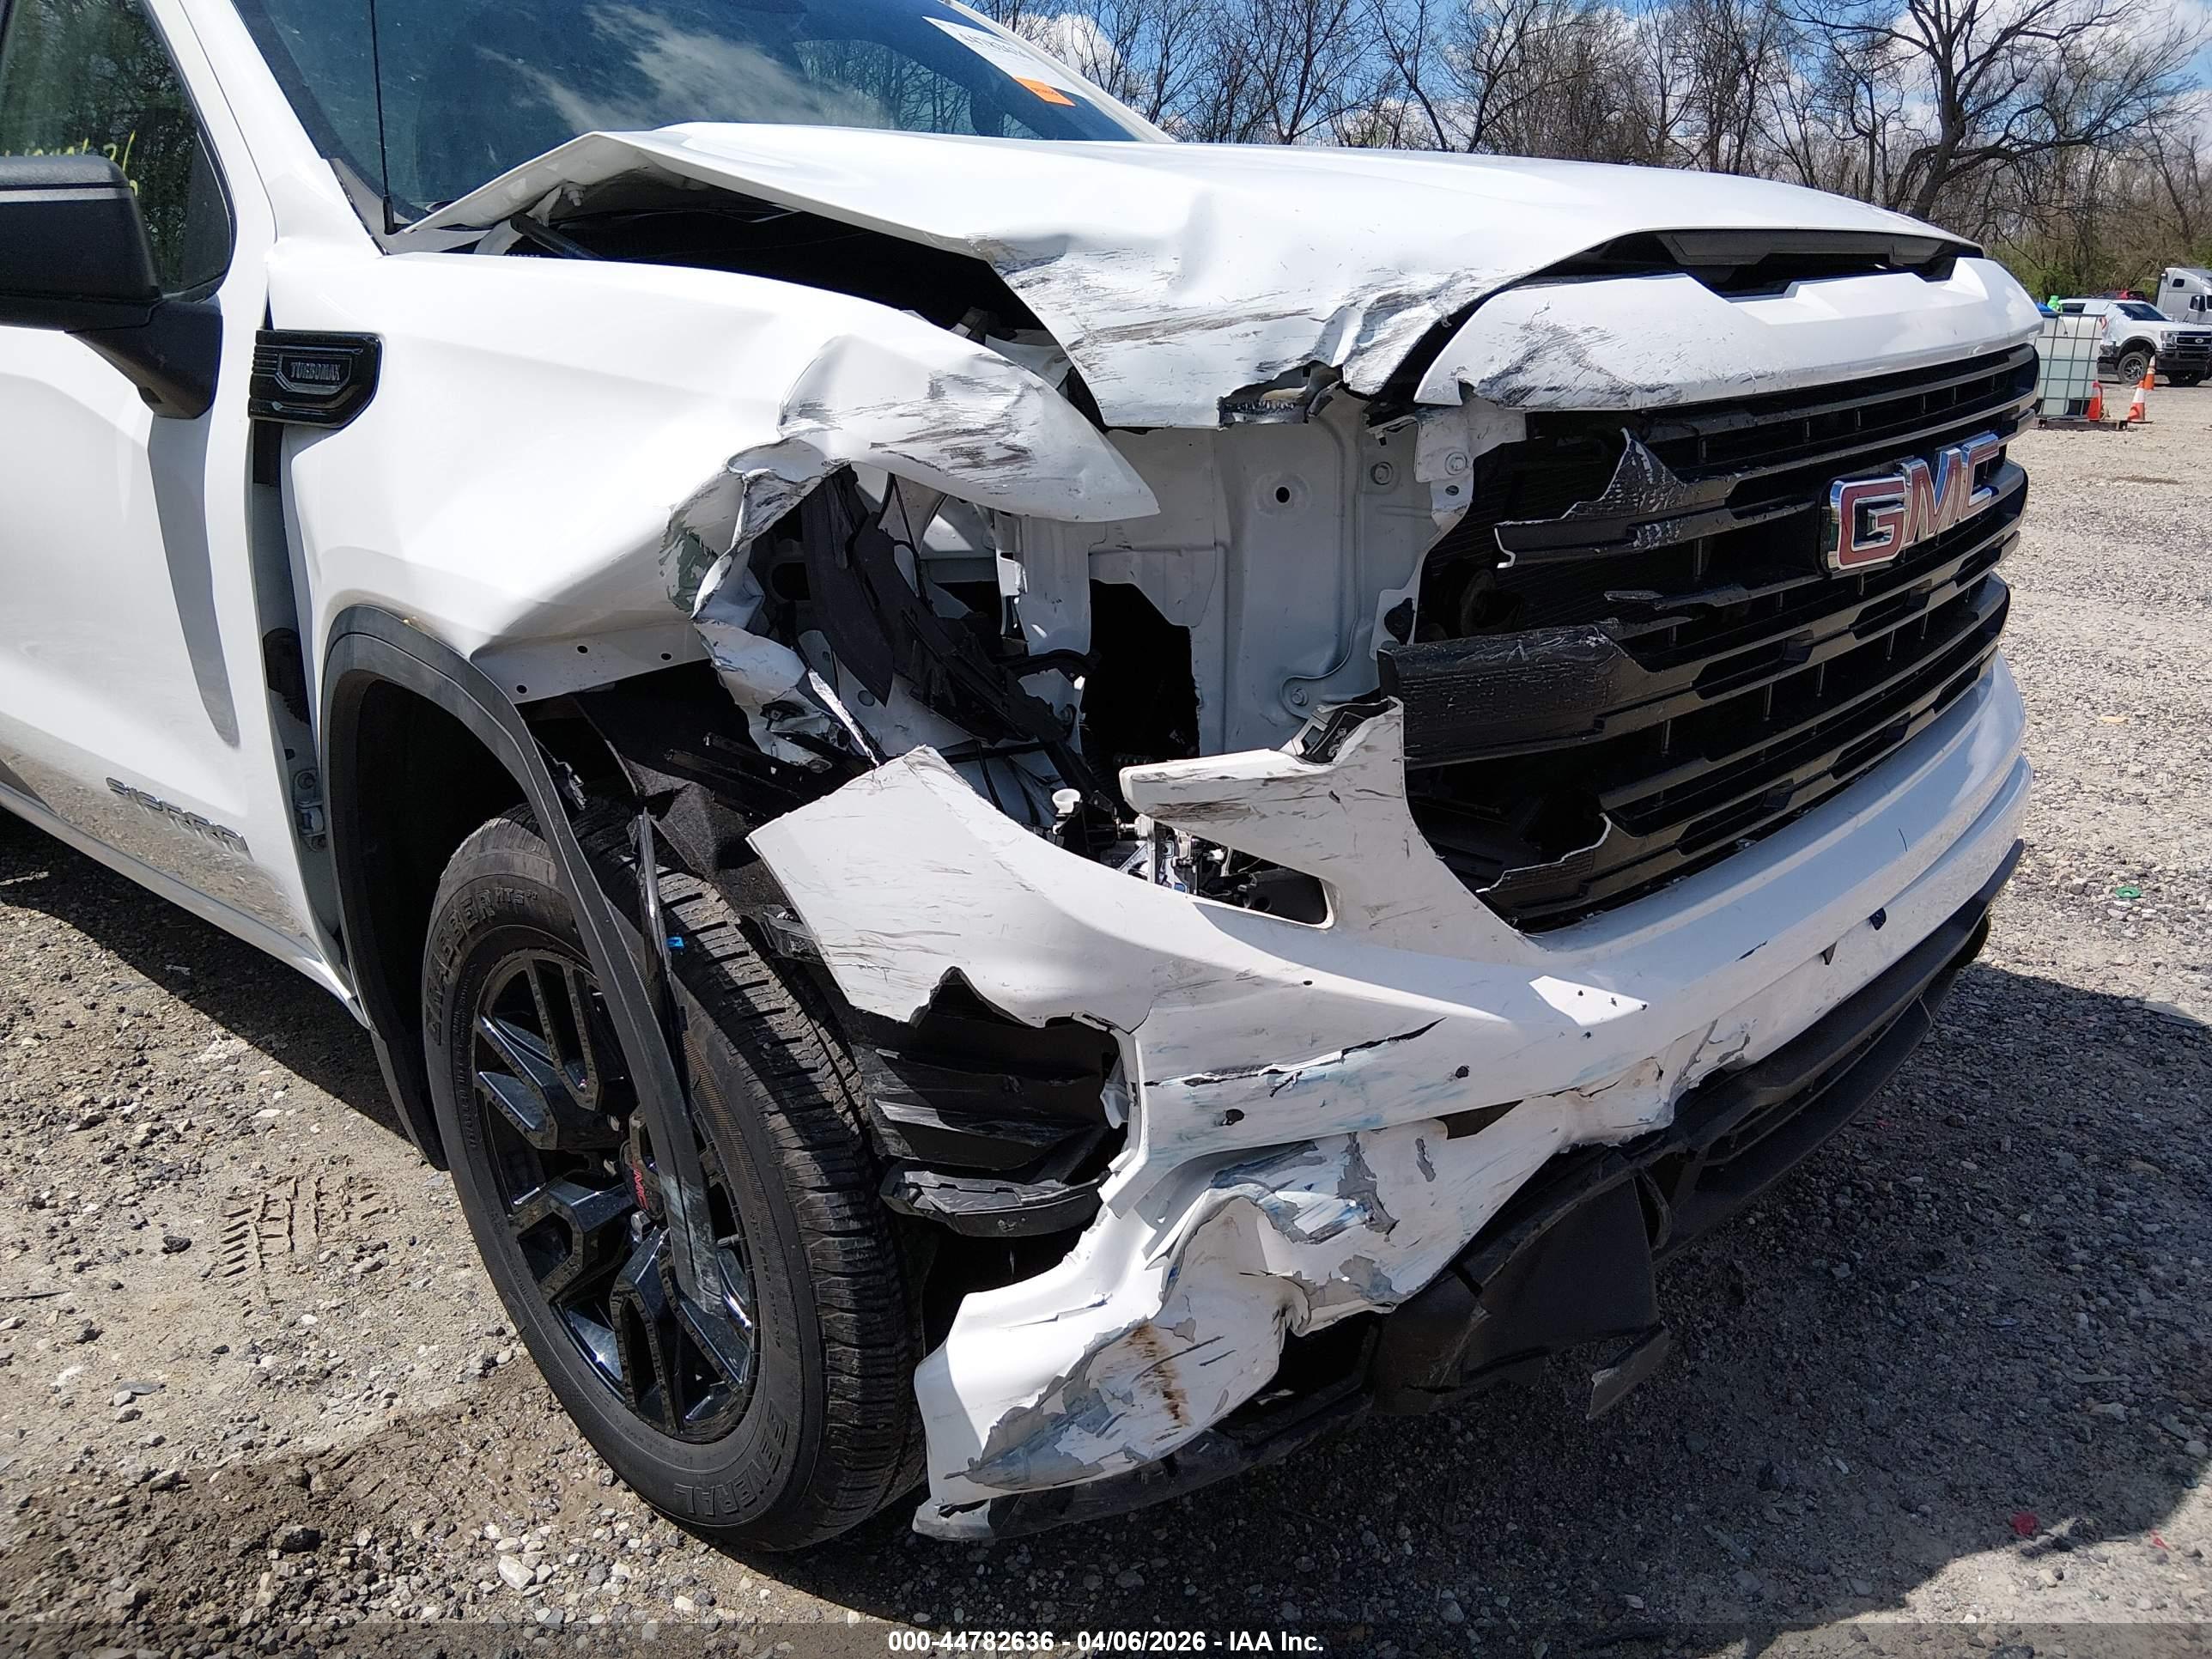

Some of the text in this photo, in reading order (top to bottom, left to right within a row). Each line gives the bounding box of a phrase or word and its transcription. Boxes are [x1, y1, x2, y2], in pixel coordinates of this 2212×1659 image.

[290, 361, 341, 381] TURBOMAX
[1827, 433, 2000, 569] GMC
[673, 1398, 788, 1516] GENERAL
